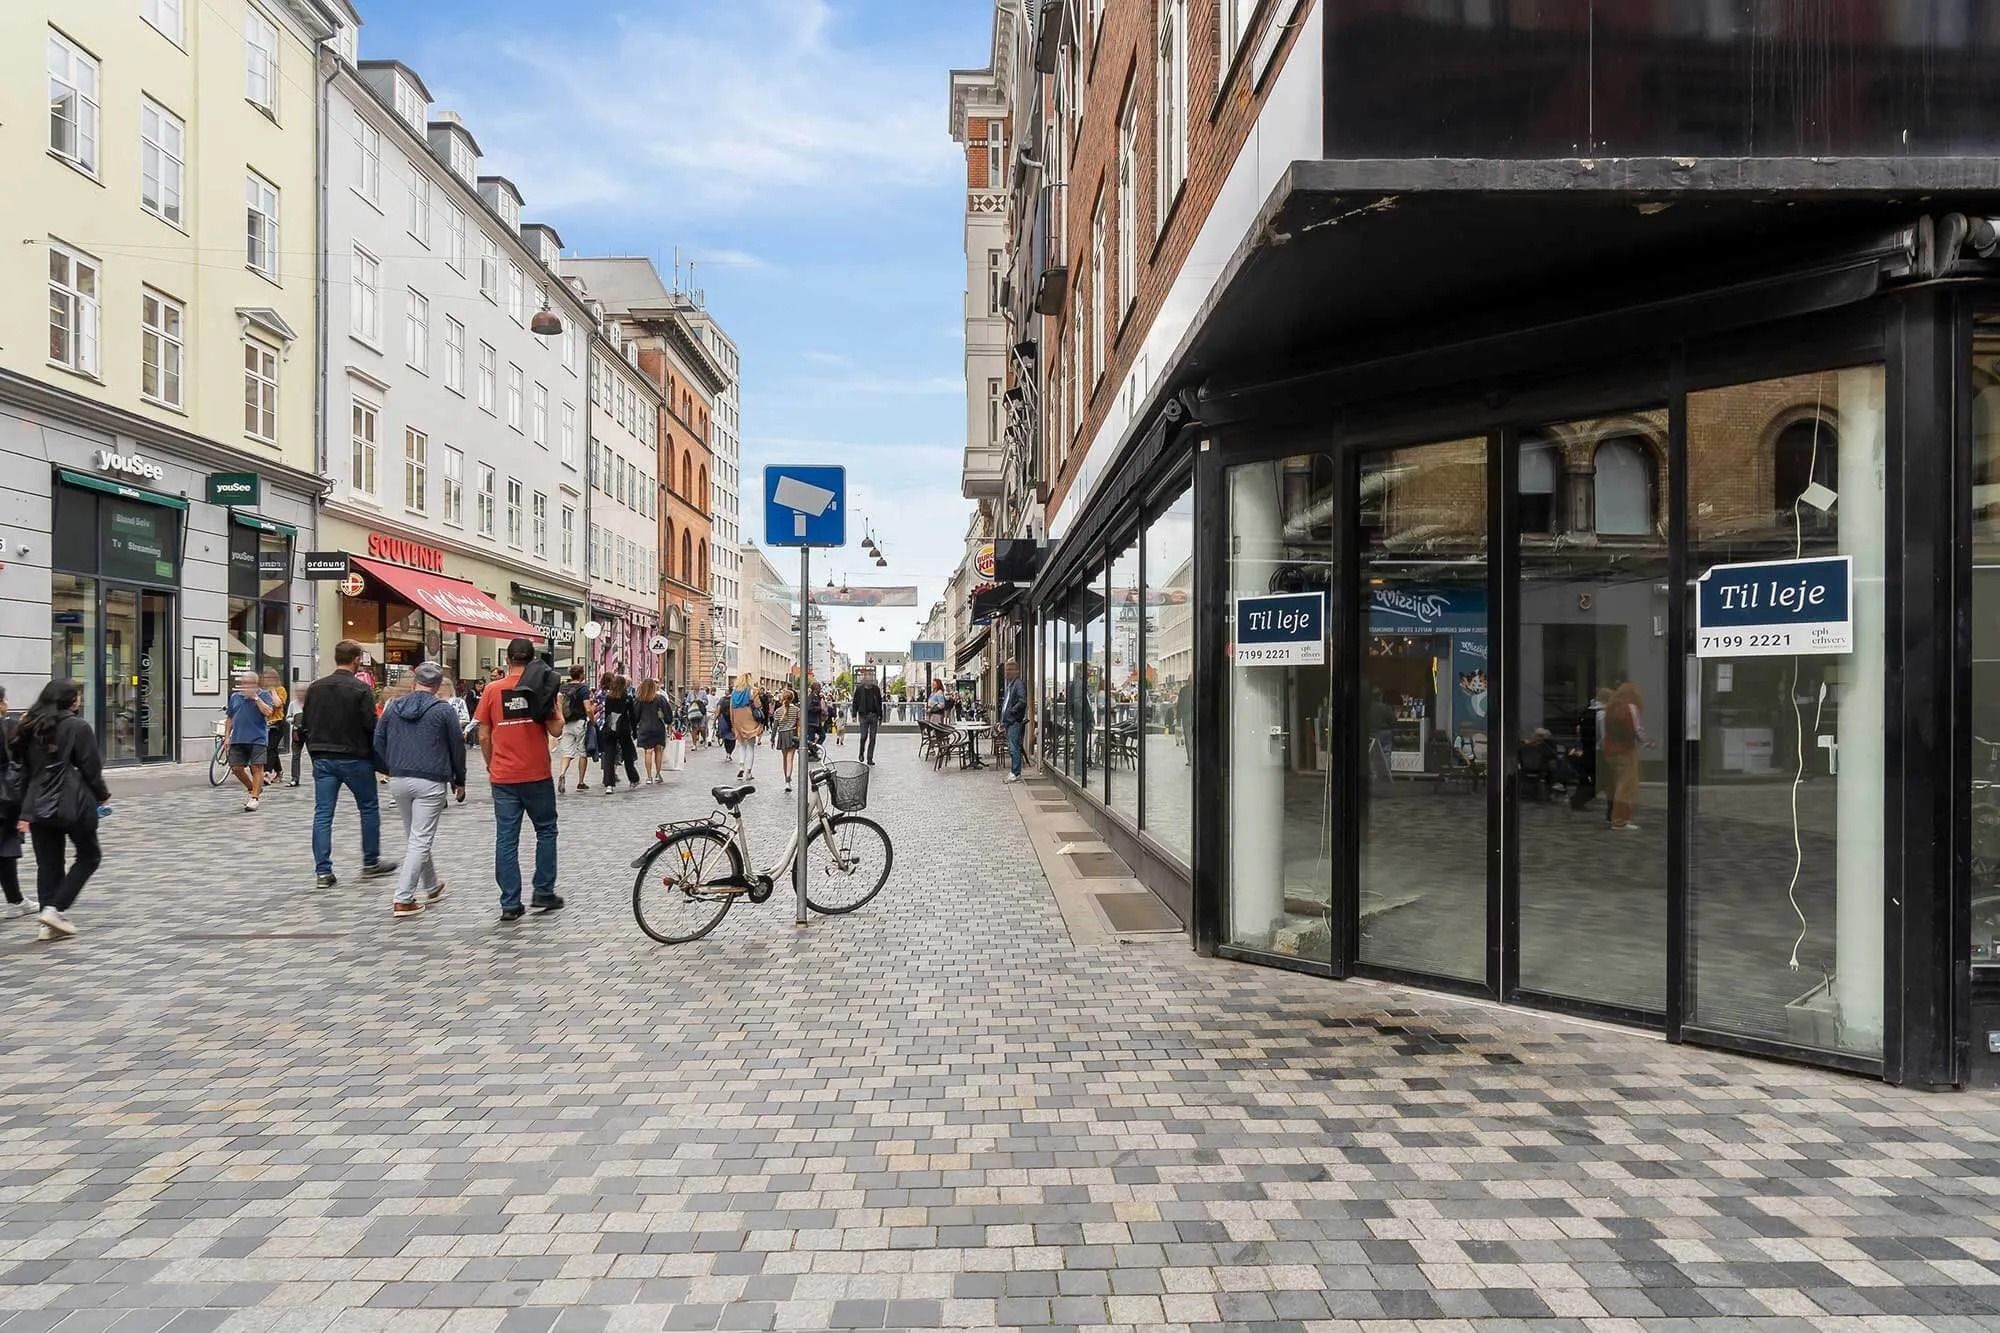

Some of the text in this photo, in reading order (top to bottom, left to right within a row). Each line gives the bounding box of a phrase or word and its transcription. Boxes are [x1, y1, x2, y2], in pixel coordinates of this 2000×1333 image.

[99, 449, 164, 480] youSee
[216, 482, 252, 493] youSee
[231, 551, 255, 562] youSee
[368, 532, 444, 572] SOUVENIR
[307, 560, 346, 568] ordnung
[1719, 580, 1826, 613] Til leje
[1249, 609, 1310, 634] Til leje
[550, 627, 576, 642] CONCEPT
[1702, 634, 1791, 649] 7199 2221
[1239, 649, 1290, 660] 7199 2221
